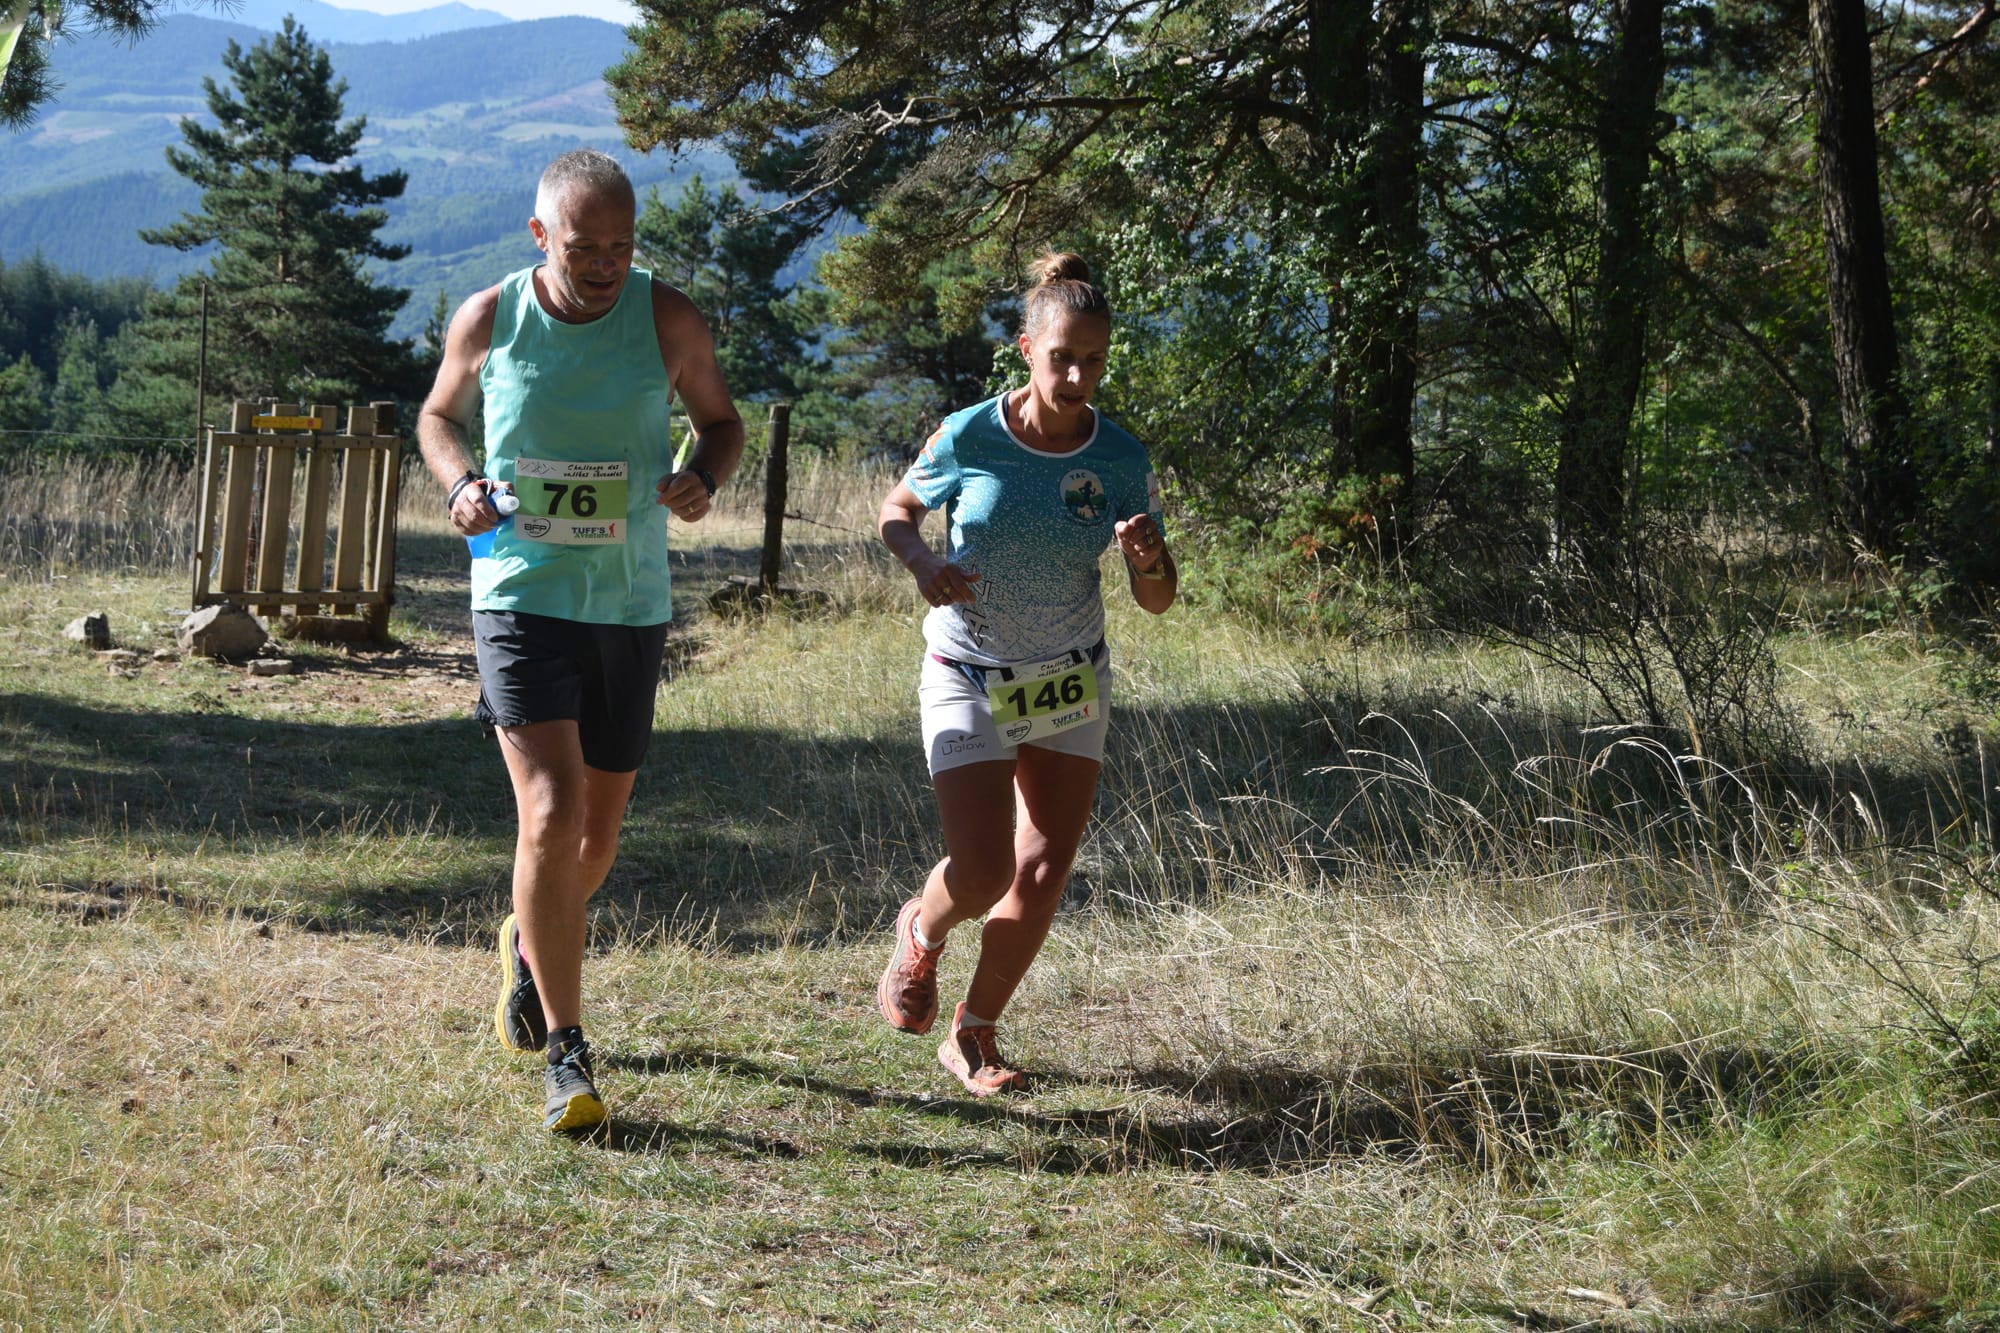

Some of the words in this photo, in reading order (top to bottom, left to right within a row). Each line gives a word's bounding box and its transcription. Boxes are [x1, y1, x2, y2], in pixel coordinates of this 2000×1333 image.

[567, 464, 604, 472] Challenge
[543, 483, 597, 517] 76
[571, 526, 606, 534] TUFF'S
[1007, 674, 1083, 717] 146
